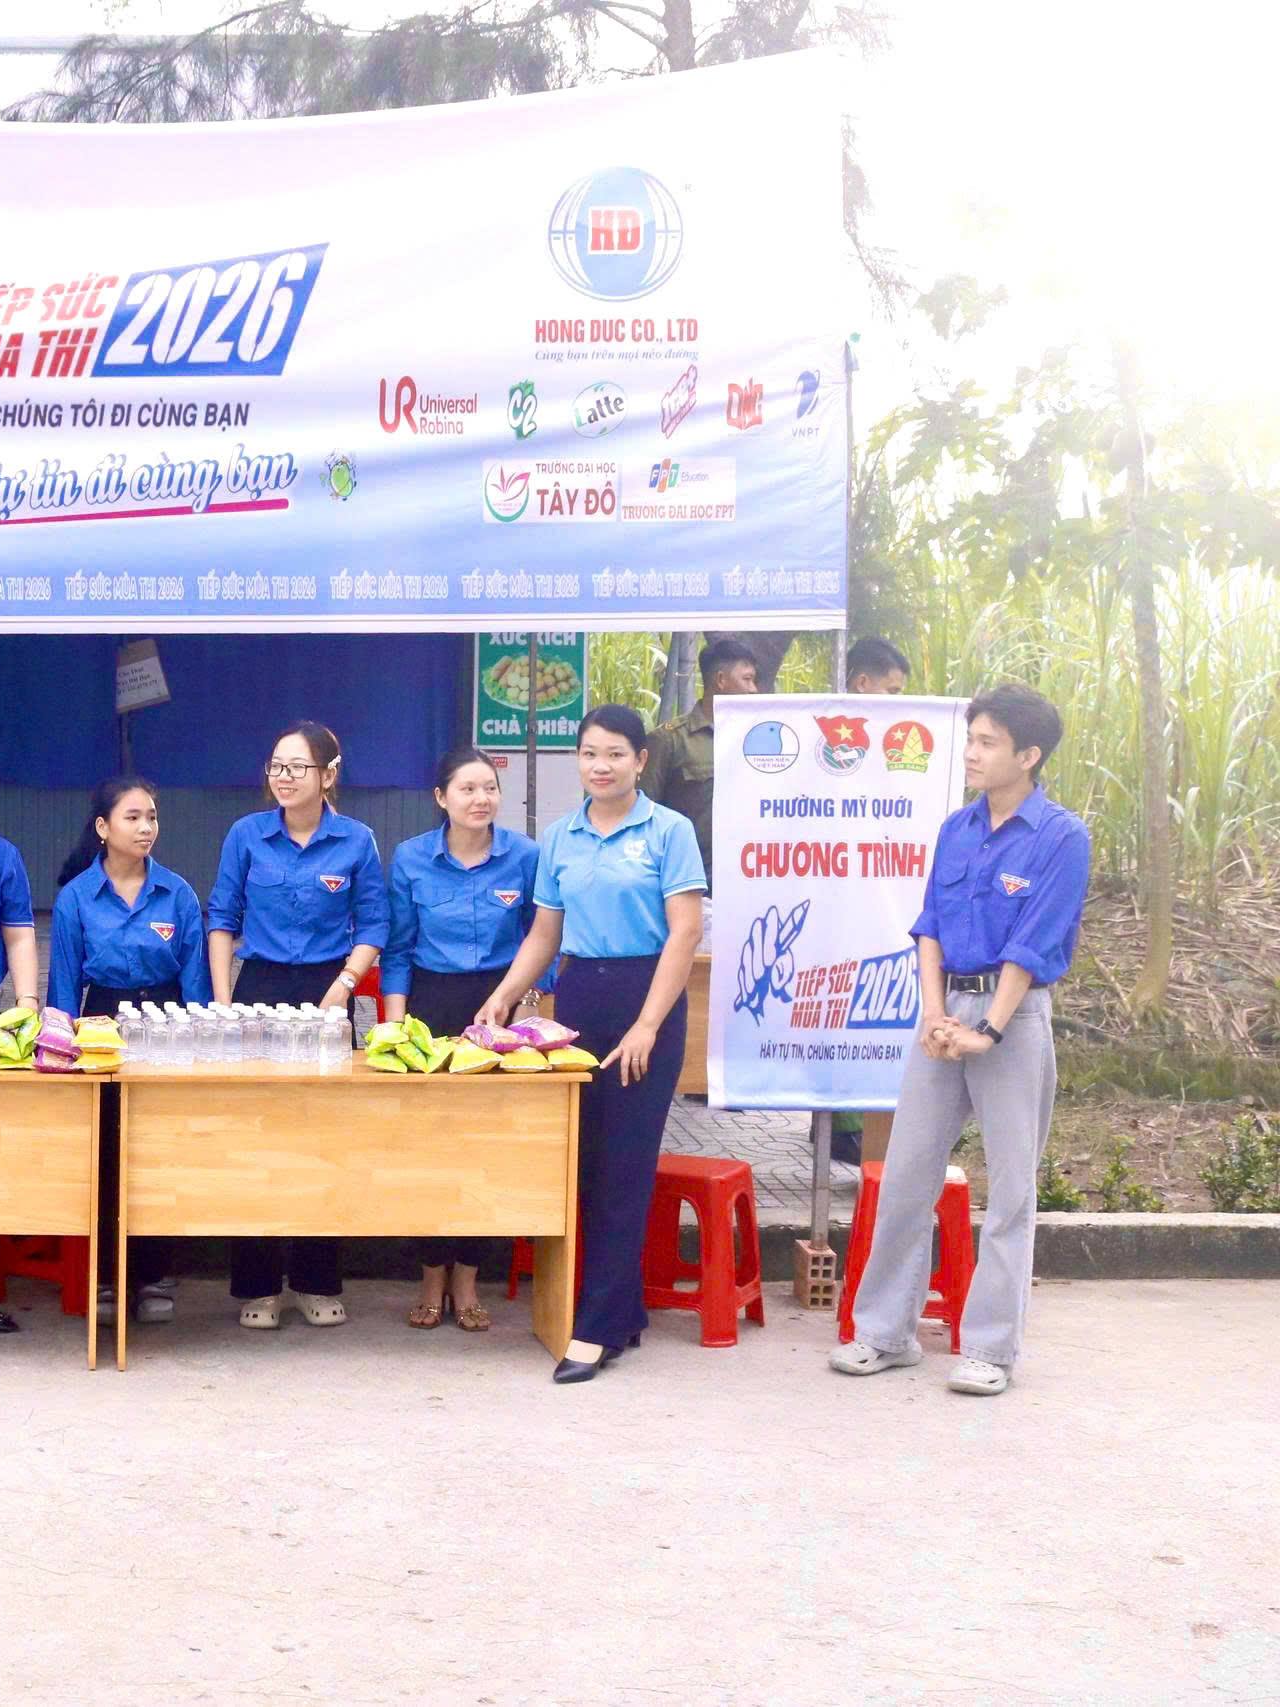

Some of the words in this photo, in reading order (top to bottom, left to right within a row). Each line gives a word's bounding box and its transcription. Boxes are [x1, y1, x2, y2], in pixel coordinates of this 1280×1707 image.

[590, 209, 641, 252] HD
[41, 270, 120, 321] SỨC
[104, 251, 309, 367] 2026
[535, 319, 585, 343] HONG
[589, 318, 626, 343] DUC
[666, 318, 698, 342] LTD
[30, 329, 98, 379] THI
[71, 399, 105, 427] TÔI
[110, 402, 132, 427] ĐI
[137, 397, 198, 428] CÙNG
[204, 402, 250, 431] BẠN
[420, 391, 478, 415] Universal
[574, 392, 626, 429] Latte
[419, 415, 464, 435] Robina
[791, 427, 819, 438] VNPT
[29, 457, 82, 511] tin
[85, 453, 127, 507] đi
[129, 449, 223, 513] cùng
[225, 442, 298, 503] bạn
[597, 461, 617, 477] HỌC
[536, 482, 579, 517] TÂY
[583, 481, 617, 516] ĐÔ
[715, 504, 735, 520] FPT
[3, 576, 22, 601] THI
[23, 576, 50, 601] 2026
[64, 570, 88, 601] TIẾP
[89, 572, 112, 601] SỨC
[112, 572, 137, 601] MÙA
[136, 576, 155, 601] THI
[156, 576, 182, 601] 2026
[197, 569, 221, 600] TIẾP
[222, 572, 245, 600] SỨC
[245, 572, 270, 600] MÙA
[269, 576, 288, 600] THI
[288, 576, 315, 600] 2026
[330, 568, 354, 600] TIẾP
[354, 572, 377, 600] SỨC
[378, 572, 402, 600] MÙA
[402, 576, 421, 600] THI
[421, 576, 448, 600] 2026
[481, 714, 521, 735] CHẢ
[526, 716, 581, 735] HIÊN
[760, 794, 835, 818] PHƯỜNG
[841, 795, 867, 818] MỸ
[872, 796, 913, 819] QUỚI
[741, 841, 848, 878] CHƯƠNG
[857, 836, 927, 878] TRÌNH
[795, 964, 826, 998] TIẾP
[828, 958, 859, 994] SỨC
[851, 950, 919, 1022] 2026
[790, 999, 823, 1029] MÙA
[824, 998, 849, 1029] THI
[779, 1043, 791, 1061] TỰ
[791, 1044, 805, 1062] TIN,
[807, 1042, 836, 1060] CHÚNG
[837, 1042, 850, 1060] TÔI
[852, 1044, 861, 1060] ĐI
[861, 1042, 883, 1060] CÙNG
[885, 1045, 903, 1063] BẠN
